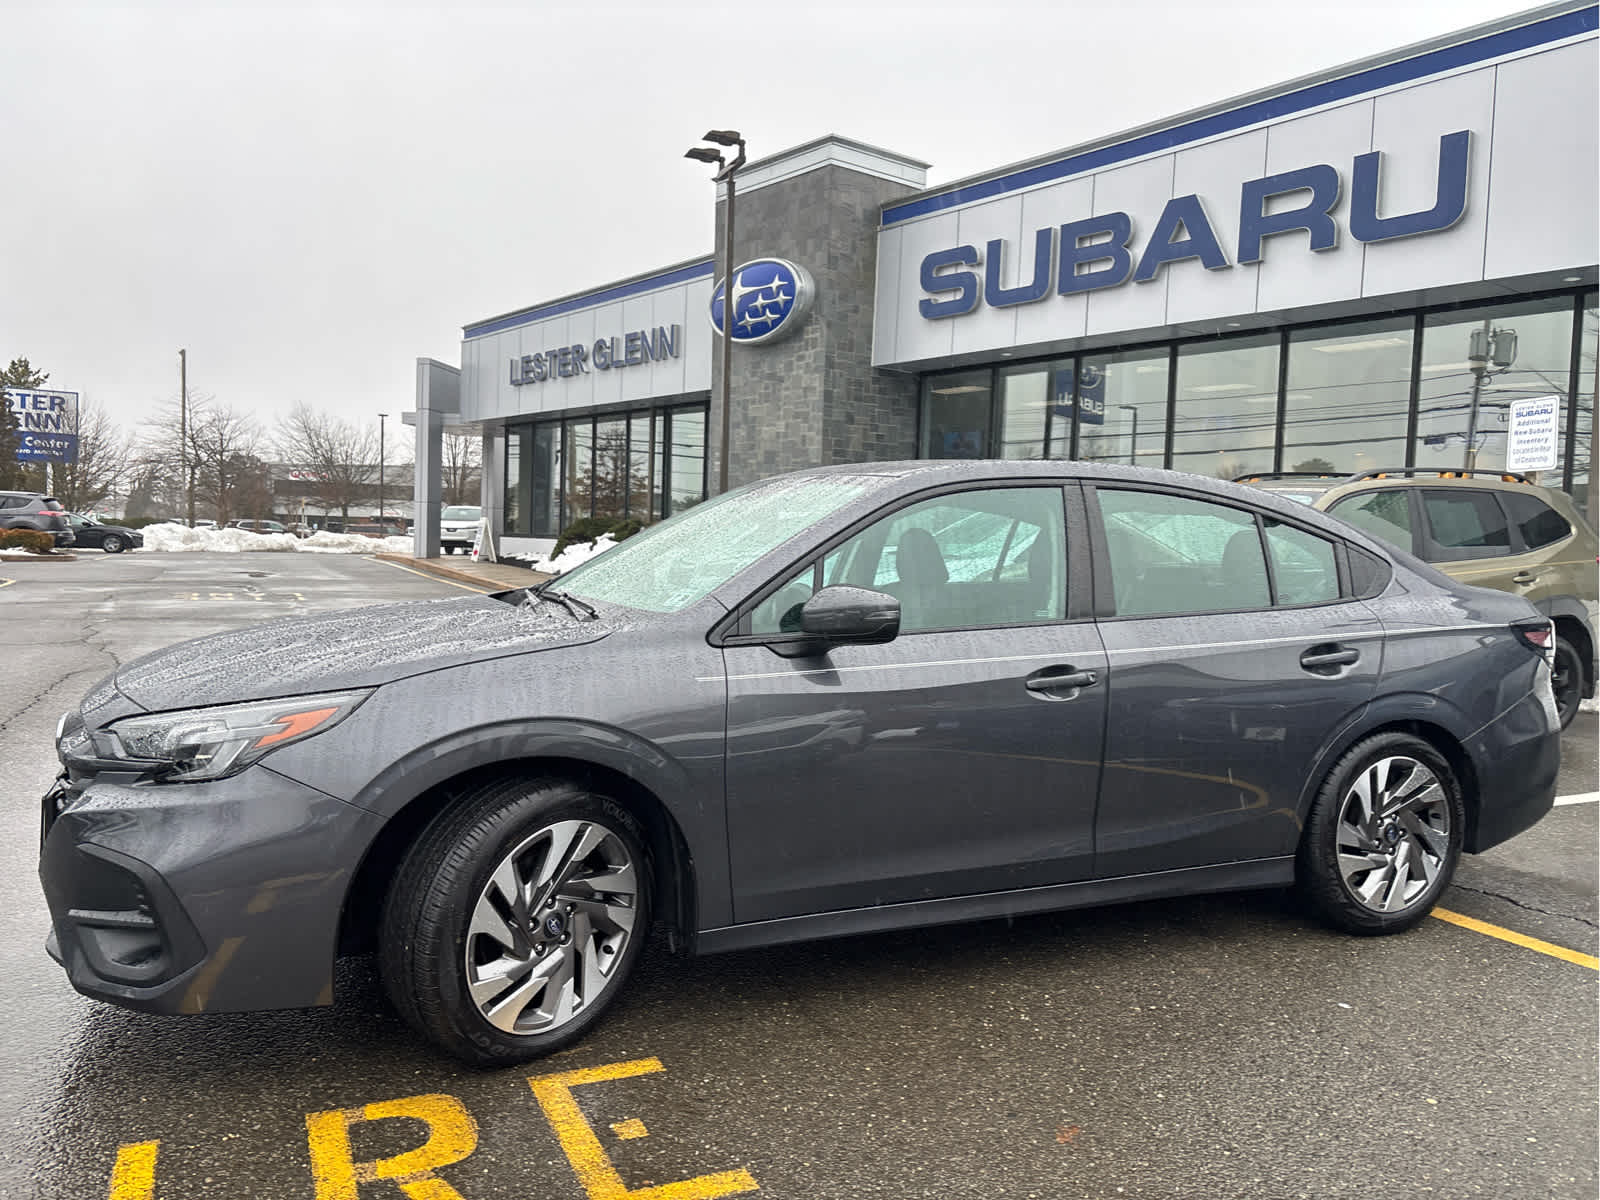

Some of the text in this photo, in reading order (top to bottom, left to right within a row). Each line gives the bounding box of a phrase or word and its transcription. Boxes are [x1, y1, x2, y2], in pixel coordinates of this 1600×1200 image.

[918, 129, 1474, 320] SUBARU
[510, 323, 681, 386] LESTER GLENN
[1515, 408, 1553, 417] SUBARU
[1517, 418, 1551, 426] Additional
